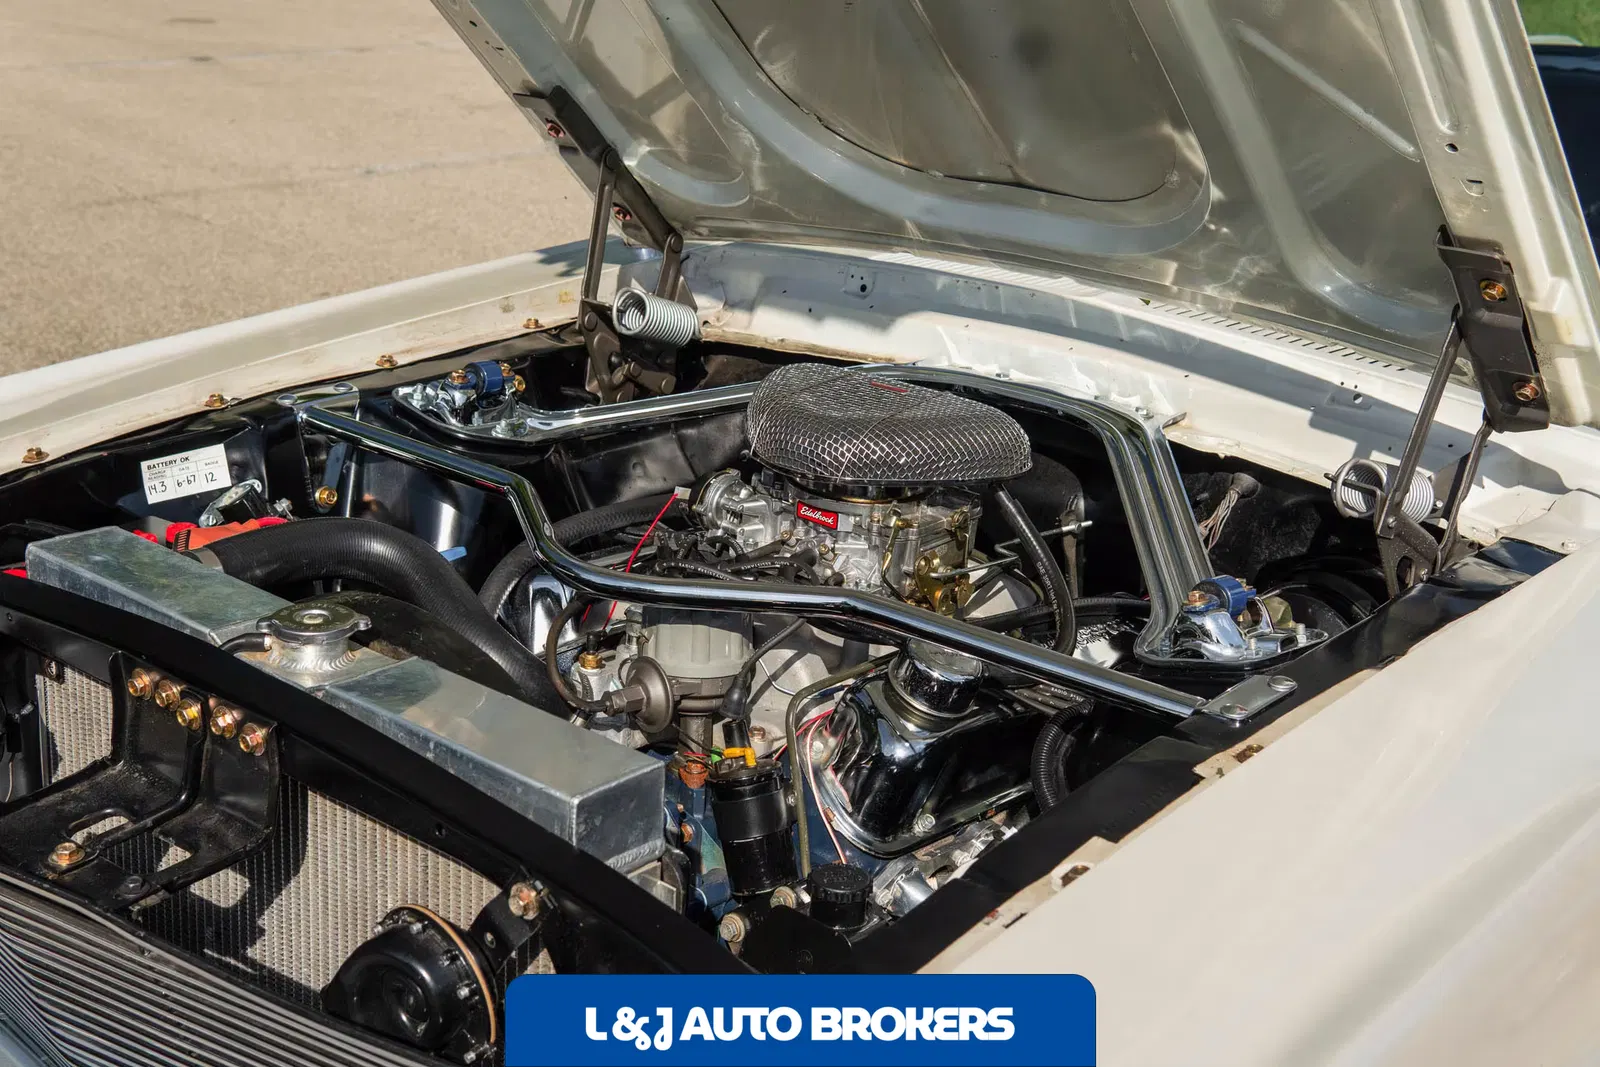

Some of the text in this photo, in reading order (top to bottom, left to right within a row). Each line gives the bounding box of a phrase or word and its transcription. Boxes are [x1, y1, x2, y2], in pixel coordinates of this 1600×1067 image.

[147, 459, 178, 471] BATTERY
[204, 472, 218, 484] 12
[148, 481, 167, 496] 14.3
[800, 506, 834, 525] Edelbrock
